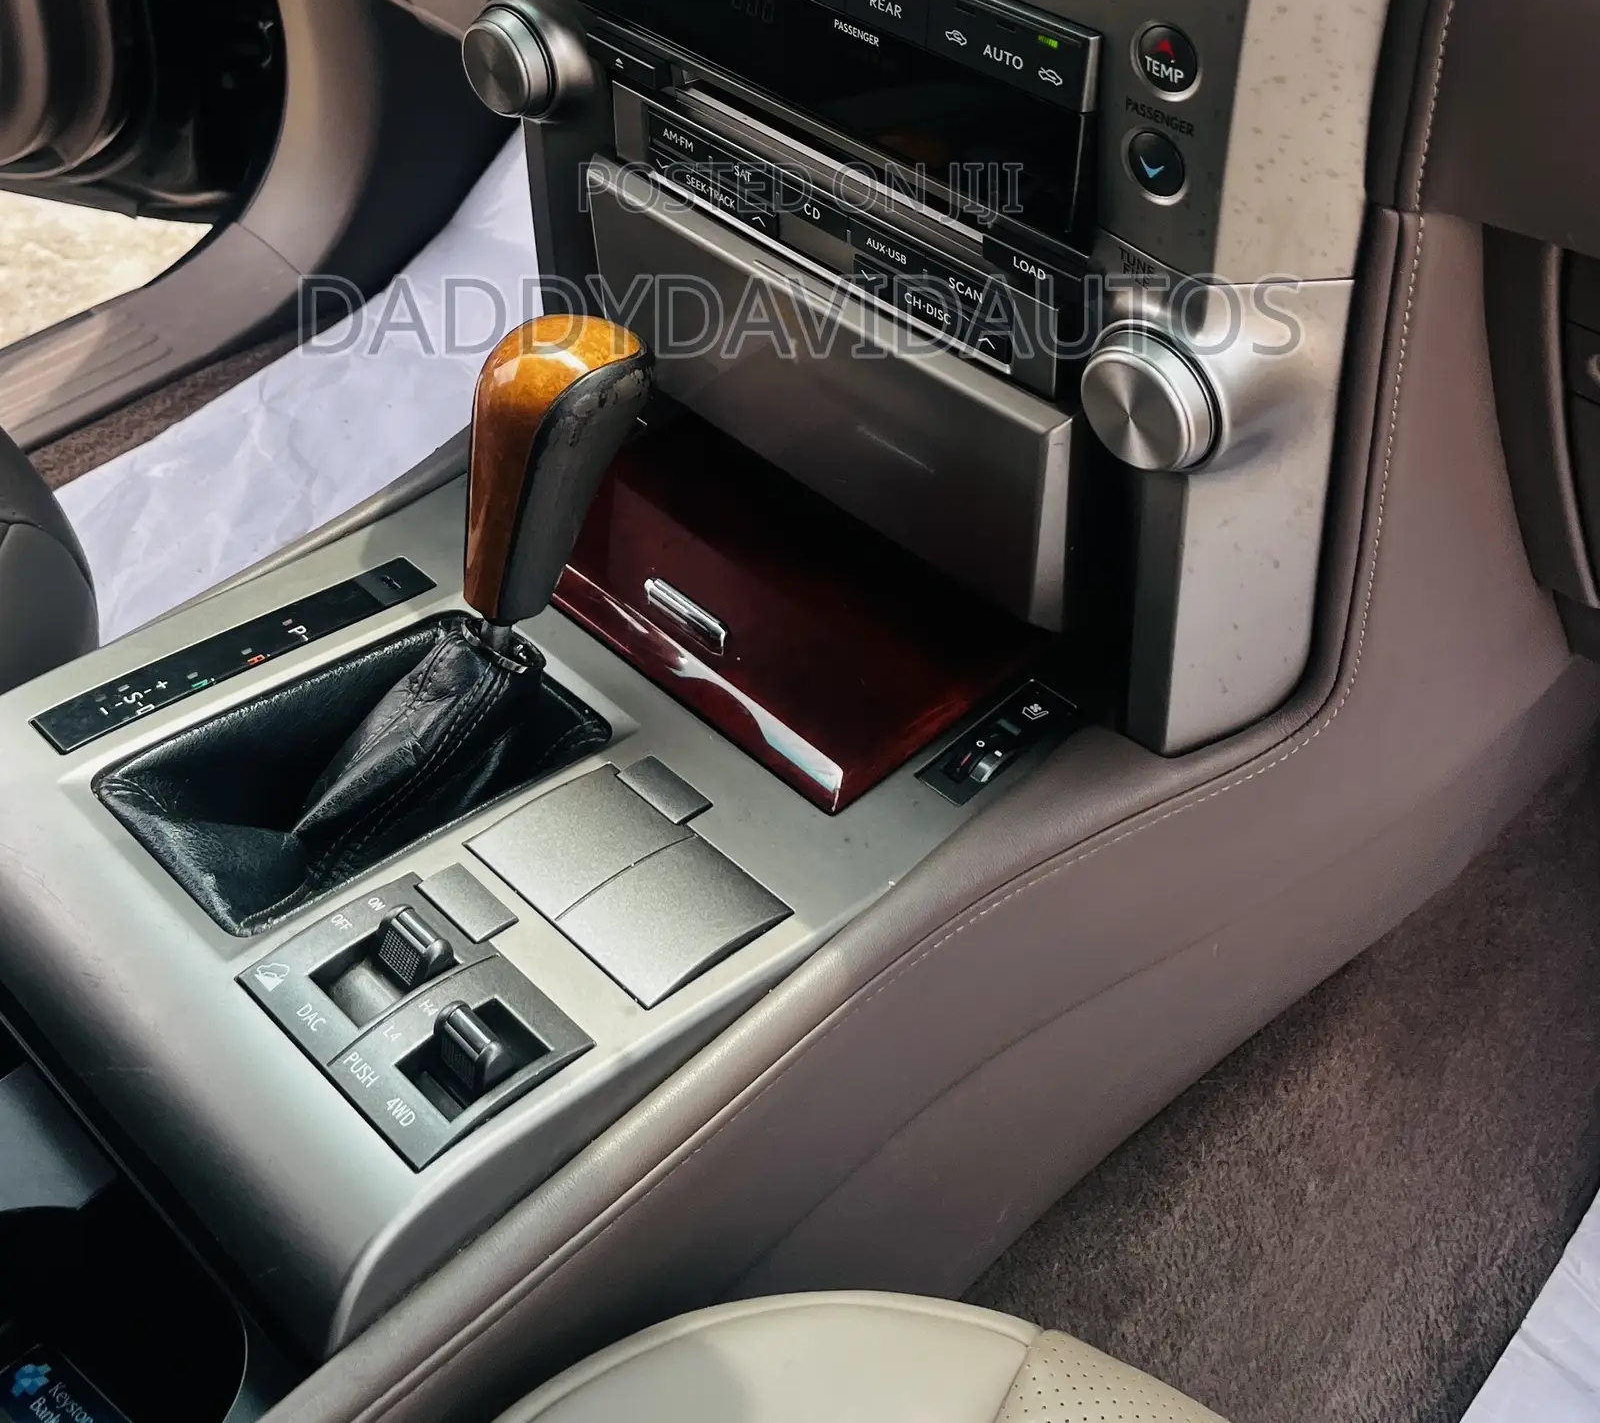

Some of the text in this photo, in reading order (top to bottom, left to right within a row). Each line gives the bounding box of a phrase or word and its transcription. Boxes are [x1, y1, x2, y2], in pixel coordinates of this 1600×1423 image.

[834, 19, 879, 47] PASSENGER
[983, 44, 1024, 70] AUTO
[1145, 55, 1184, 83] TEMP
[1126, 97, 1194, 137] PASSENGER
[733, 165, 753, 183] SAT
[803, 203, 821, 221] CD
[1013, 255, 1046, 281] LOAD
[1118, 246, 1156, 275] TUNE
[948, 277, 983, 304] SCAN
[367, 896, 386, 913] ON
[330, 913, 353, 931] OFF
[296, 1003, 327, 1032] DAC
[345, 1051, 380, 1089] PUSH
[385, 1097, 416, 1128] 4WD
